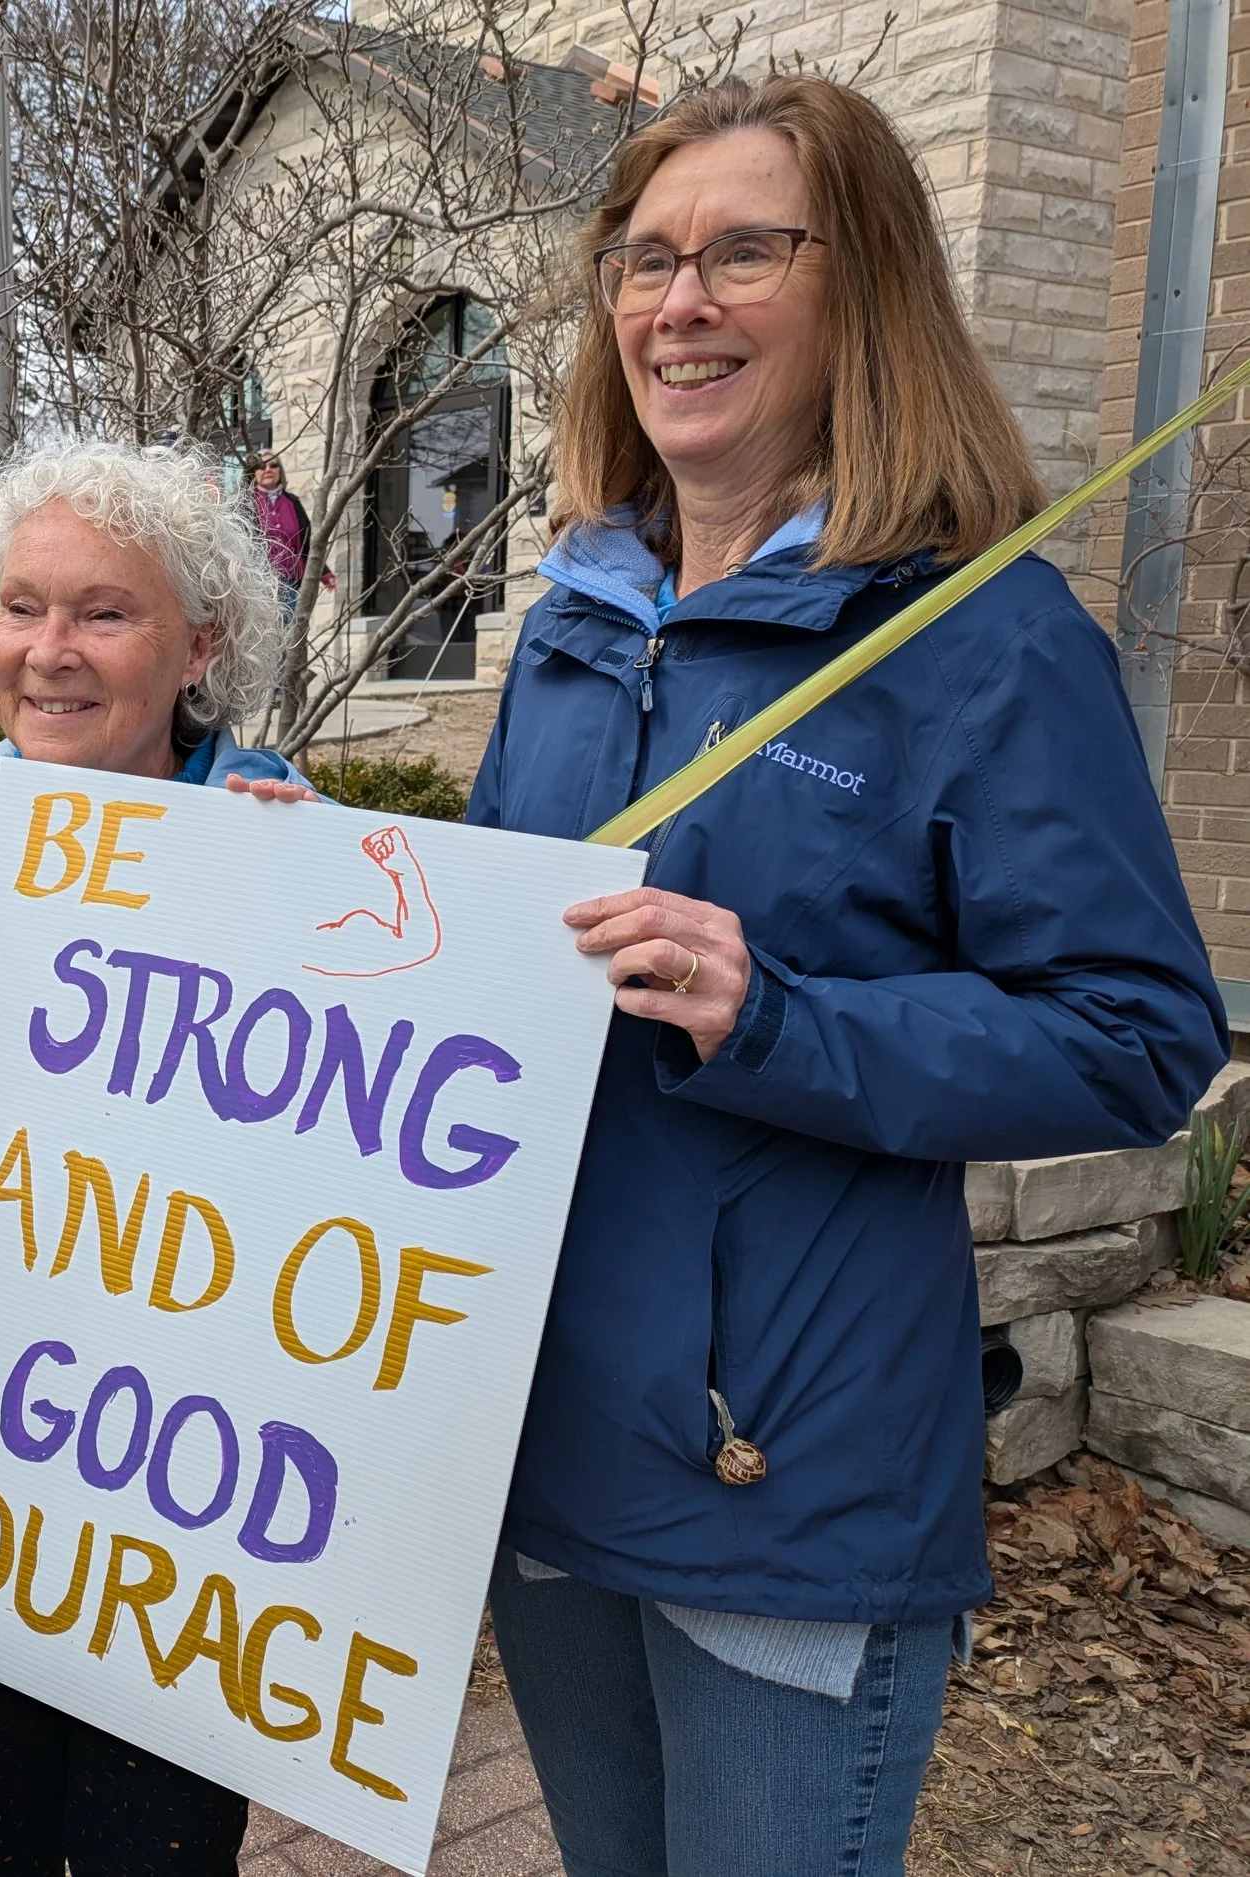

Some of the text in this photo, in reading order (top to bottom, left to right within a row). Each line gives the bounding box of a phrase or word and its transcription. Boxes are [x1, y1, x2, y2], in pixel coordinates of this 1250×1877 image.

[14, 791, 169, 910] BE
[756, 741, 866, 796] Marmot
[29, 937, 523, 1191] STRONG
[271, 1215, 496, 1392] OF
[0, 1339, 340, 1565] GOOD
